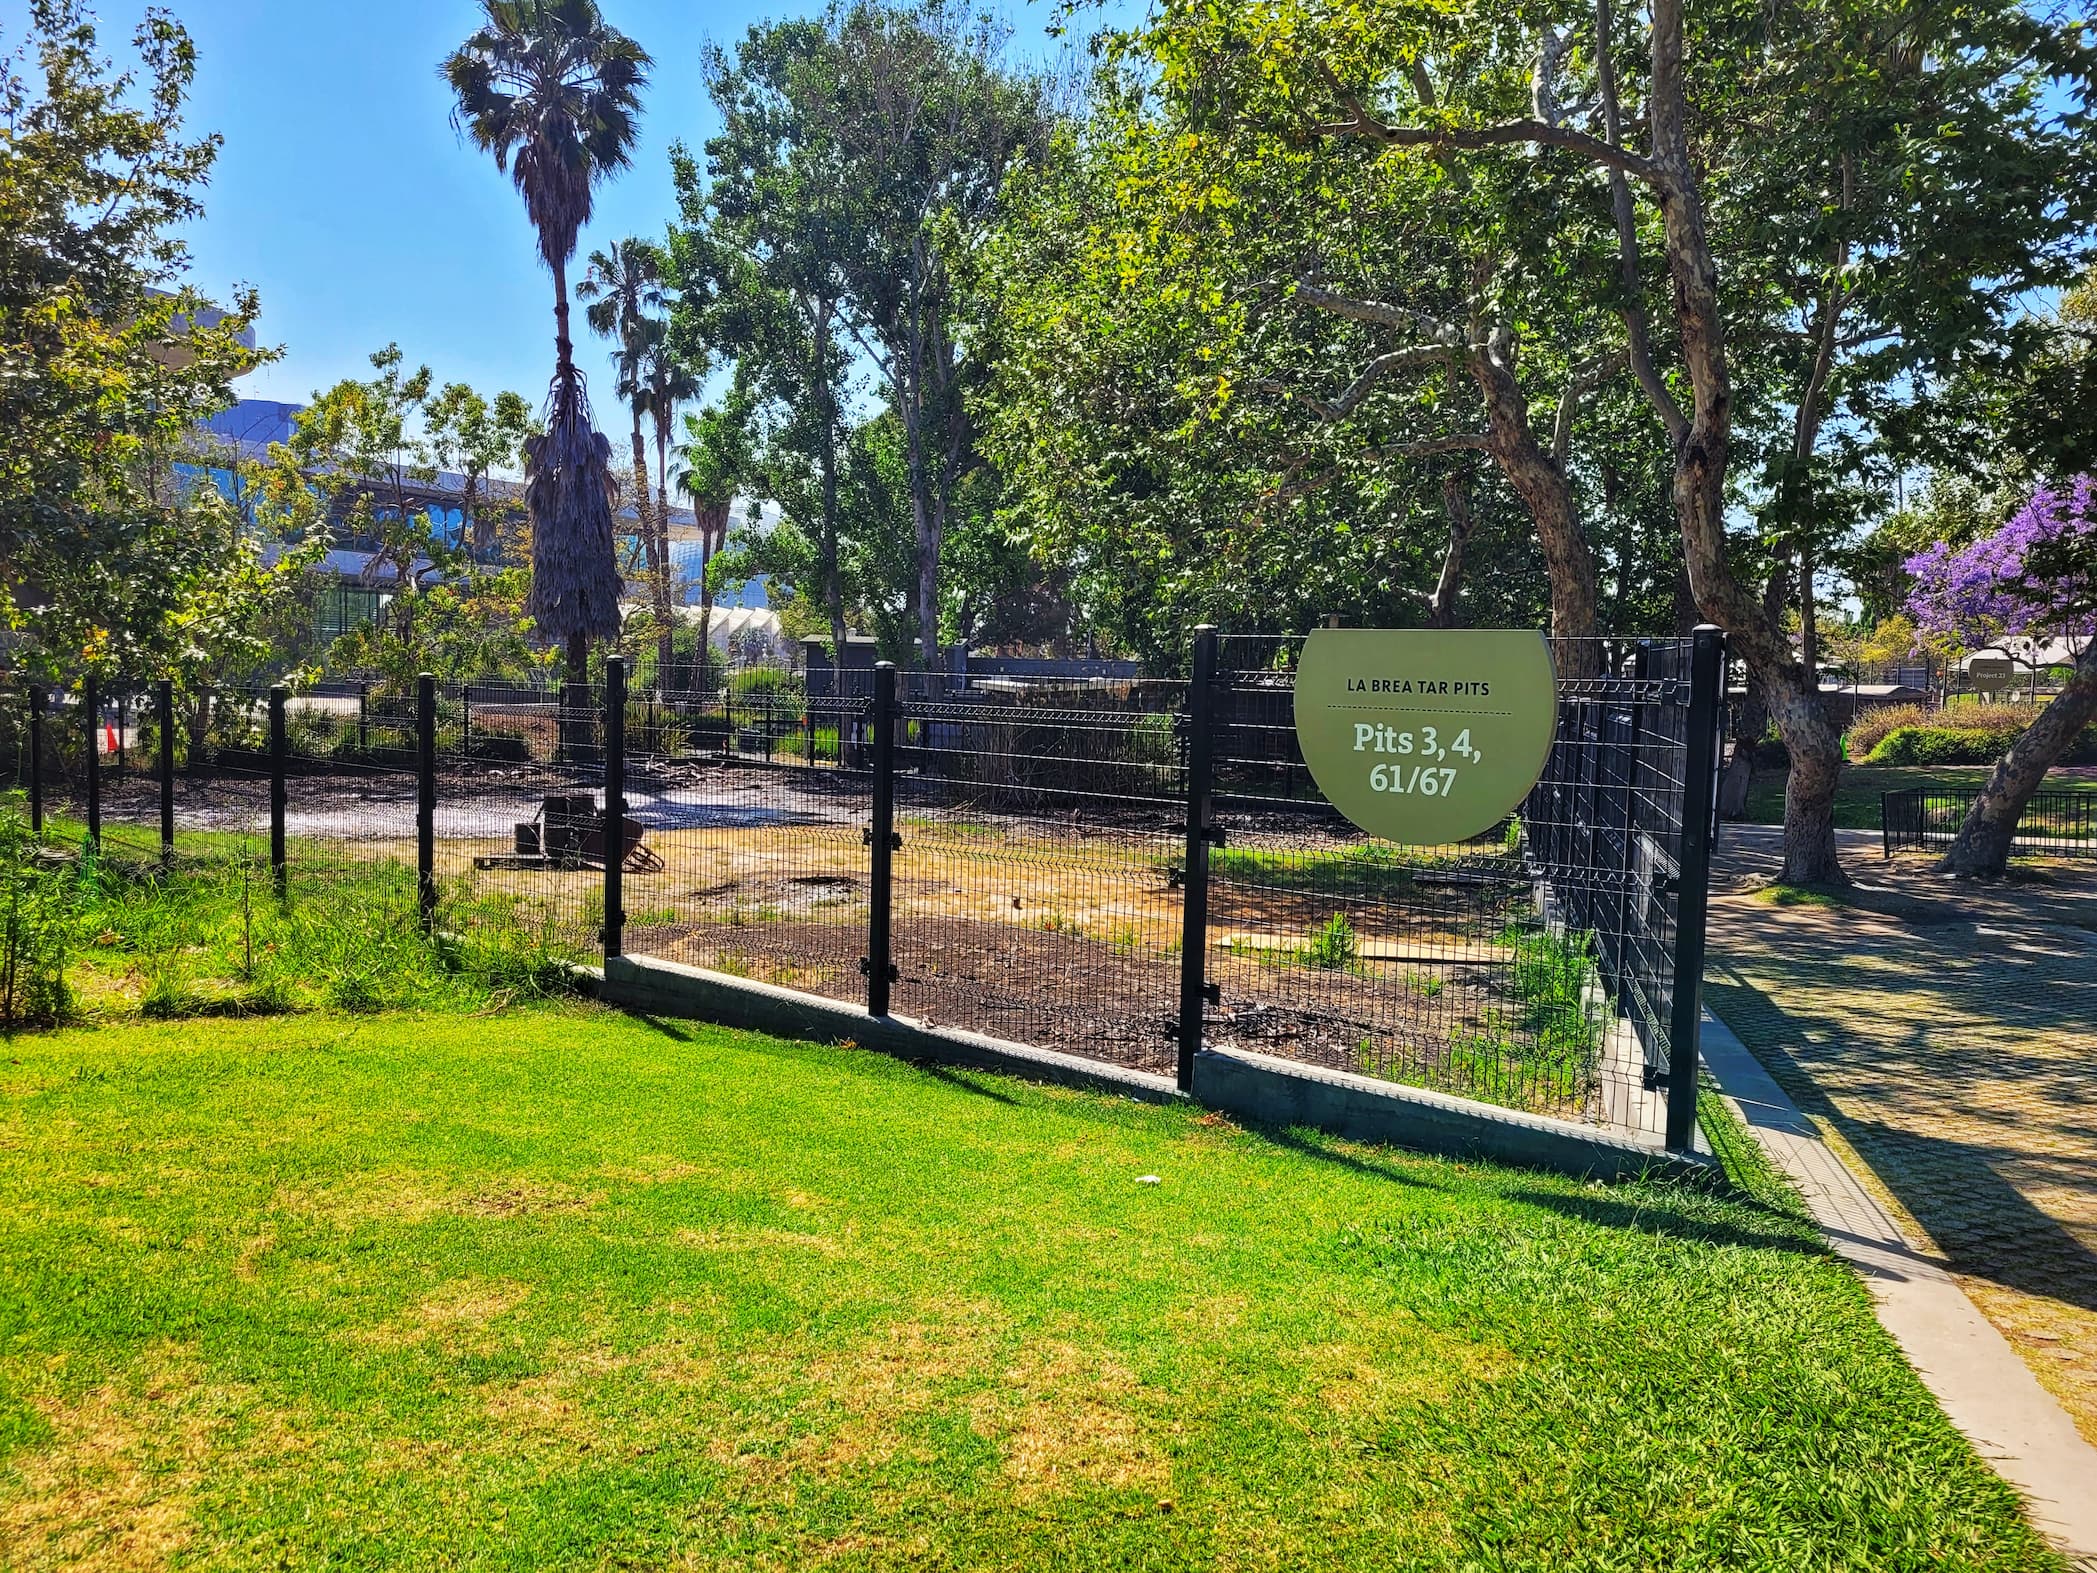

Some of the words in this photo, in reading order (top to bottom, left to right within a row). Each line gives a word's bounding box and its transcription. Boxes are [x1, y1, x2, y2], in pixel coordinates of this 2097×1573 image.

[1347, 679, 1367, 692] LA
[1371, 679, 1413, 694] BREA
[1417, 680, 1449, 695] TAR
[1453, 681, 1490, 696] PITS
[1976, 672, 1997, 680] Project
[1353, 722, 1414, 754] Pits
[1421, 726, 1446, 762] 3,
[1451, 728, 1482, 764] 4,
[1369, 763, 1457, 797] 61/67
